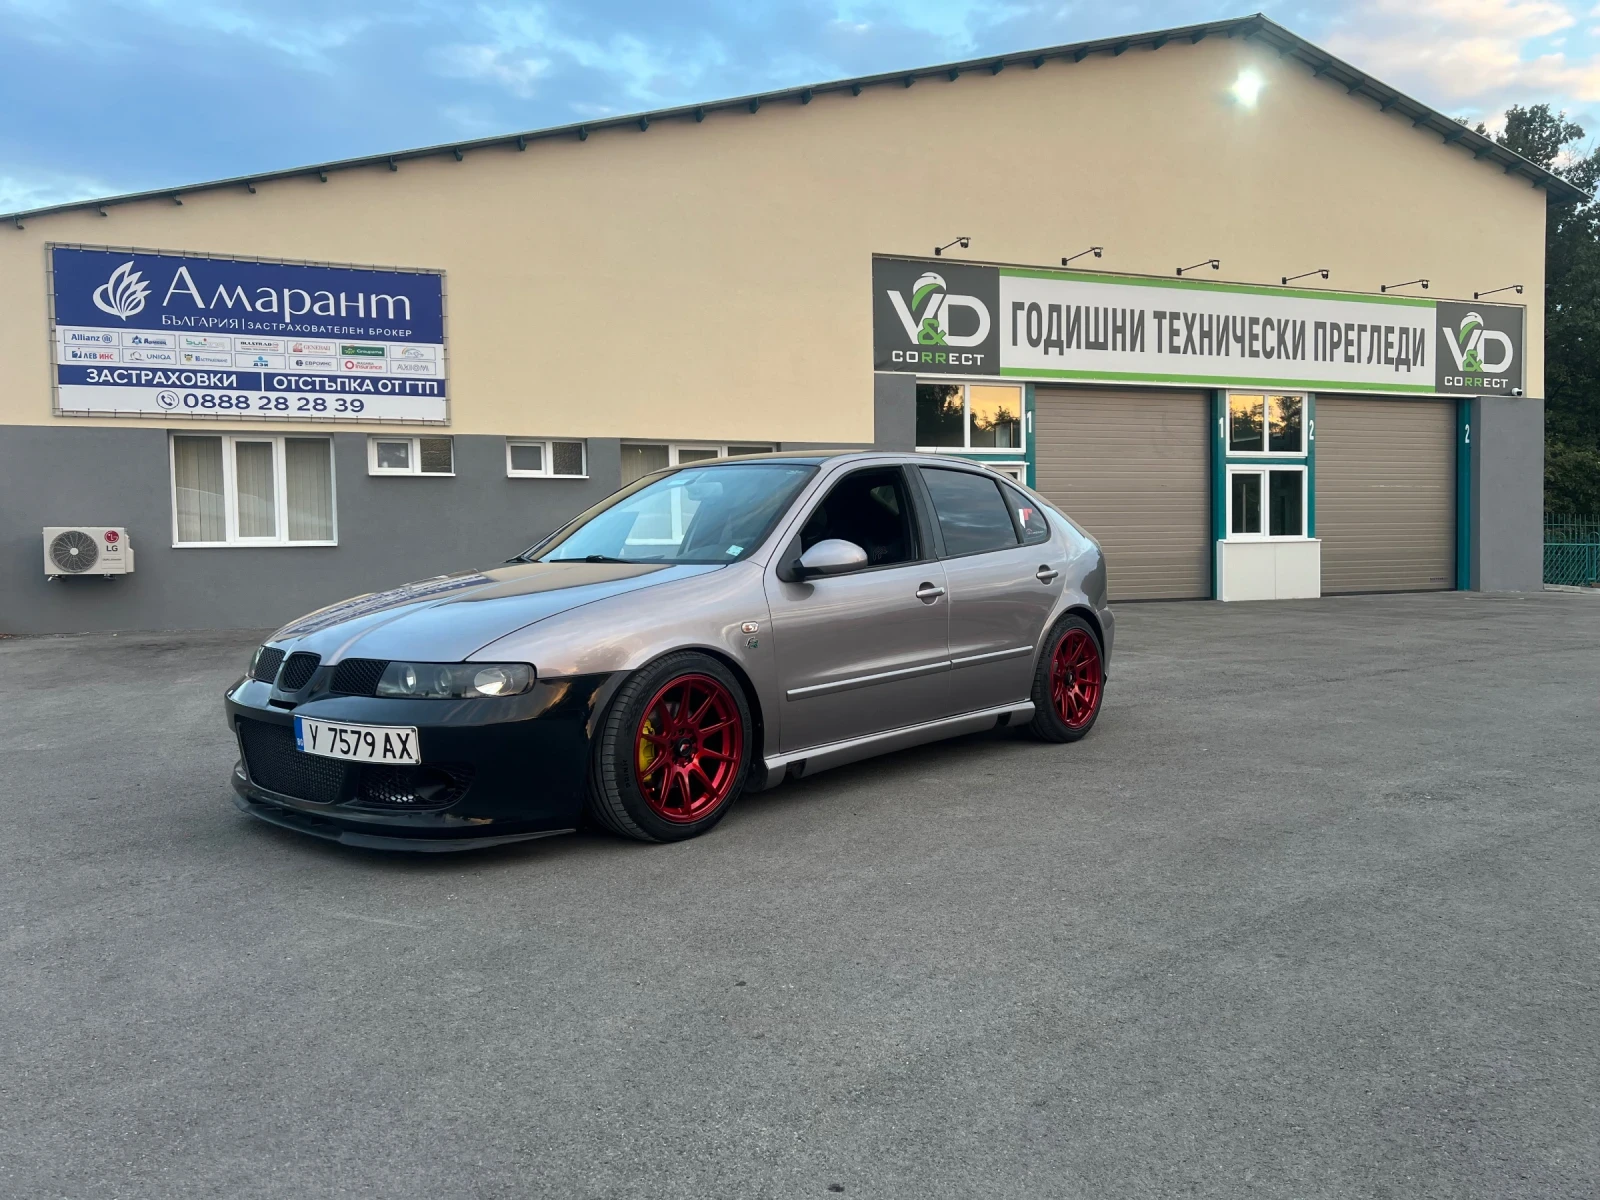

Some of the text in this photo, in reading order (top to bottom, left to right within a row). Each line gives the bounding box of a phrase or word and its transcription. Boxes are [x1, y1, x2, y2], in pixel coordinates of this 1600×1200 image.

[162, 265, 411, 323] Амарант
[162, 314, 412, 337] БЪЛГАРИЯ ЗАСТРАХОВАТЕЛЕН БРОКЕР
[71, 334, 100, 342] Allianz
[1011, 301, 1426, 372] ГОДИШНИ ТЕХНИЧЕСКИ ПРЕГЛЕДИ
[83, 352, 97, 360] ЛЕВ
[892, 350, 985, 366] CORRECT
[86, 368, 237, 388] ЗАСТРАХОВКИ
[273, 375, 438, 395] ОТСТЪПКА ОТ ГТП
[1444, 376, 1509, 388] CORRECT
[183, 393, 365, 413] 0888 28 28 39
[1026, 410, 1033, 433] 1
[1218, 417, 1225, 438] 1
[1308, 419, 1315, 441] 2
[1464, 423, 1470, 444] 2
[327, 727, 376, 758] 7579
